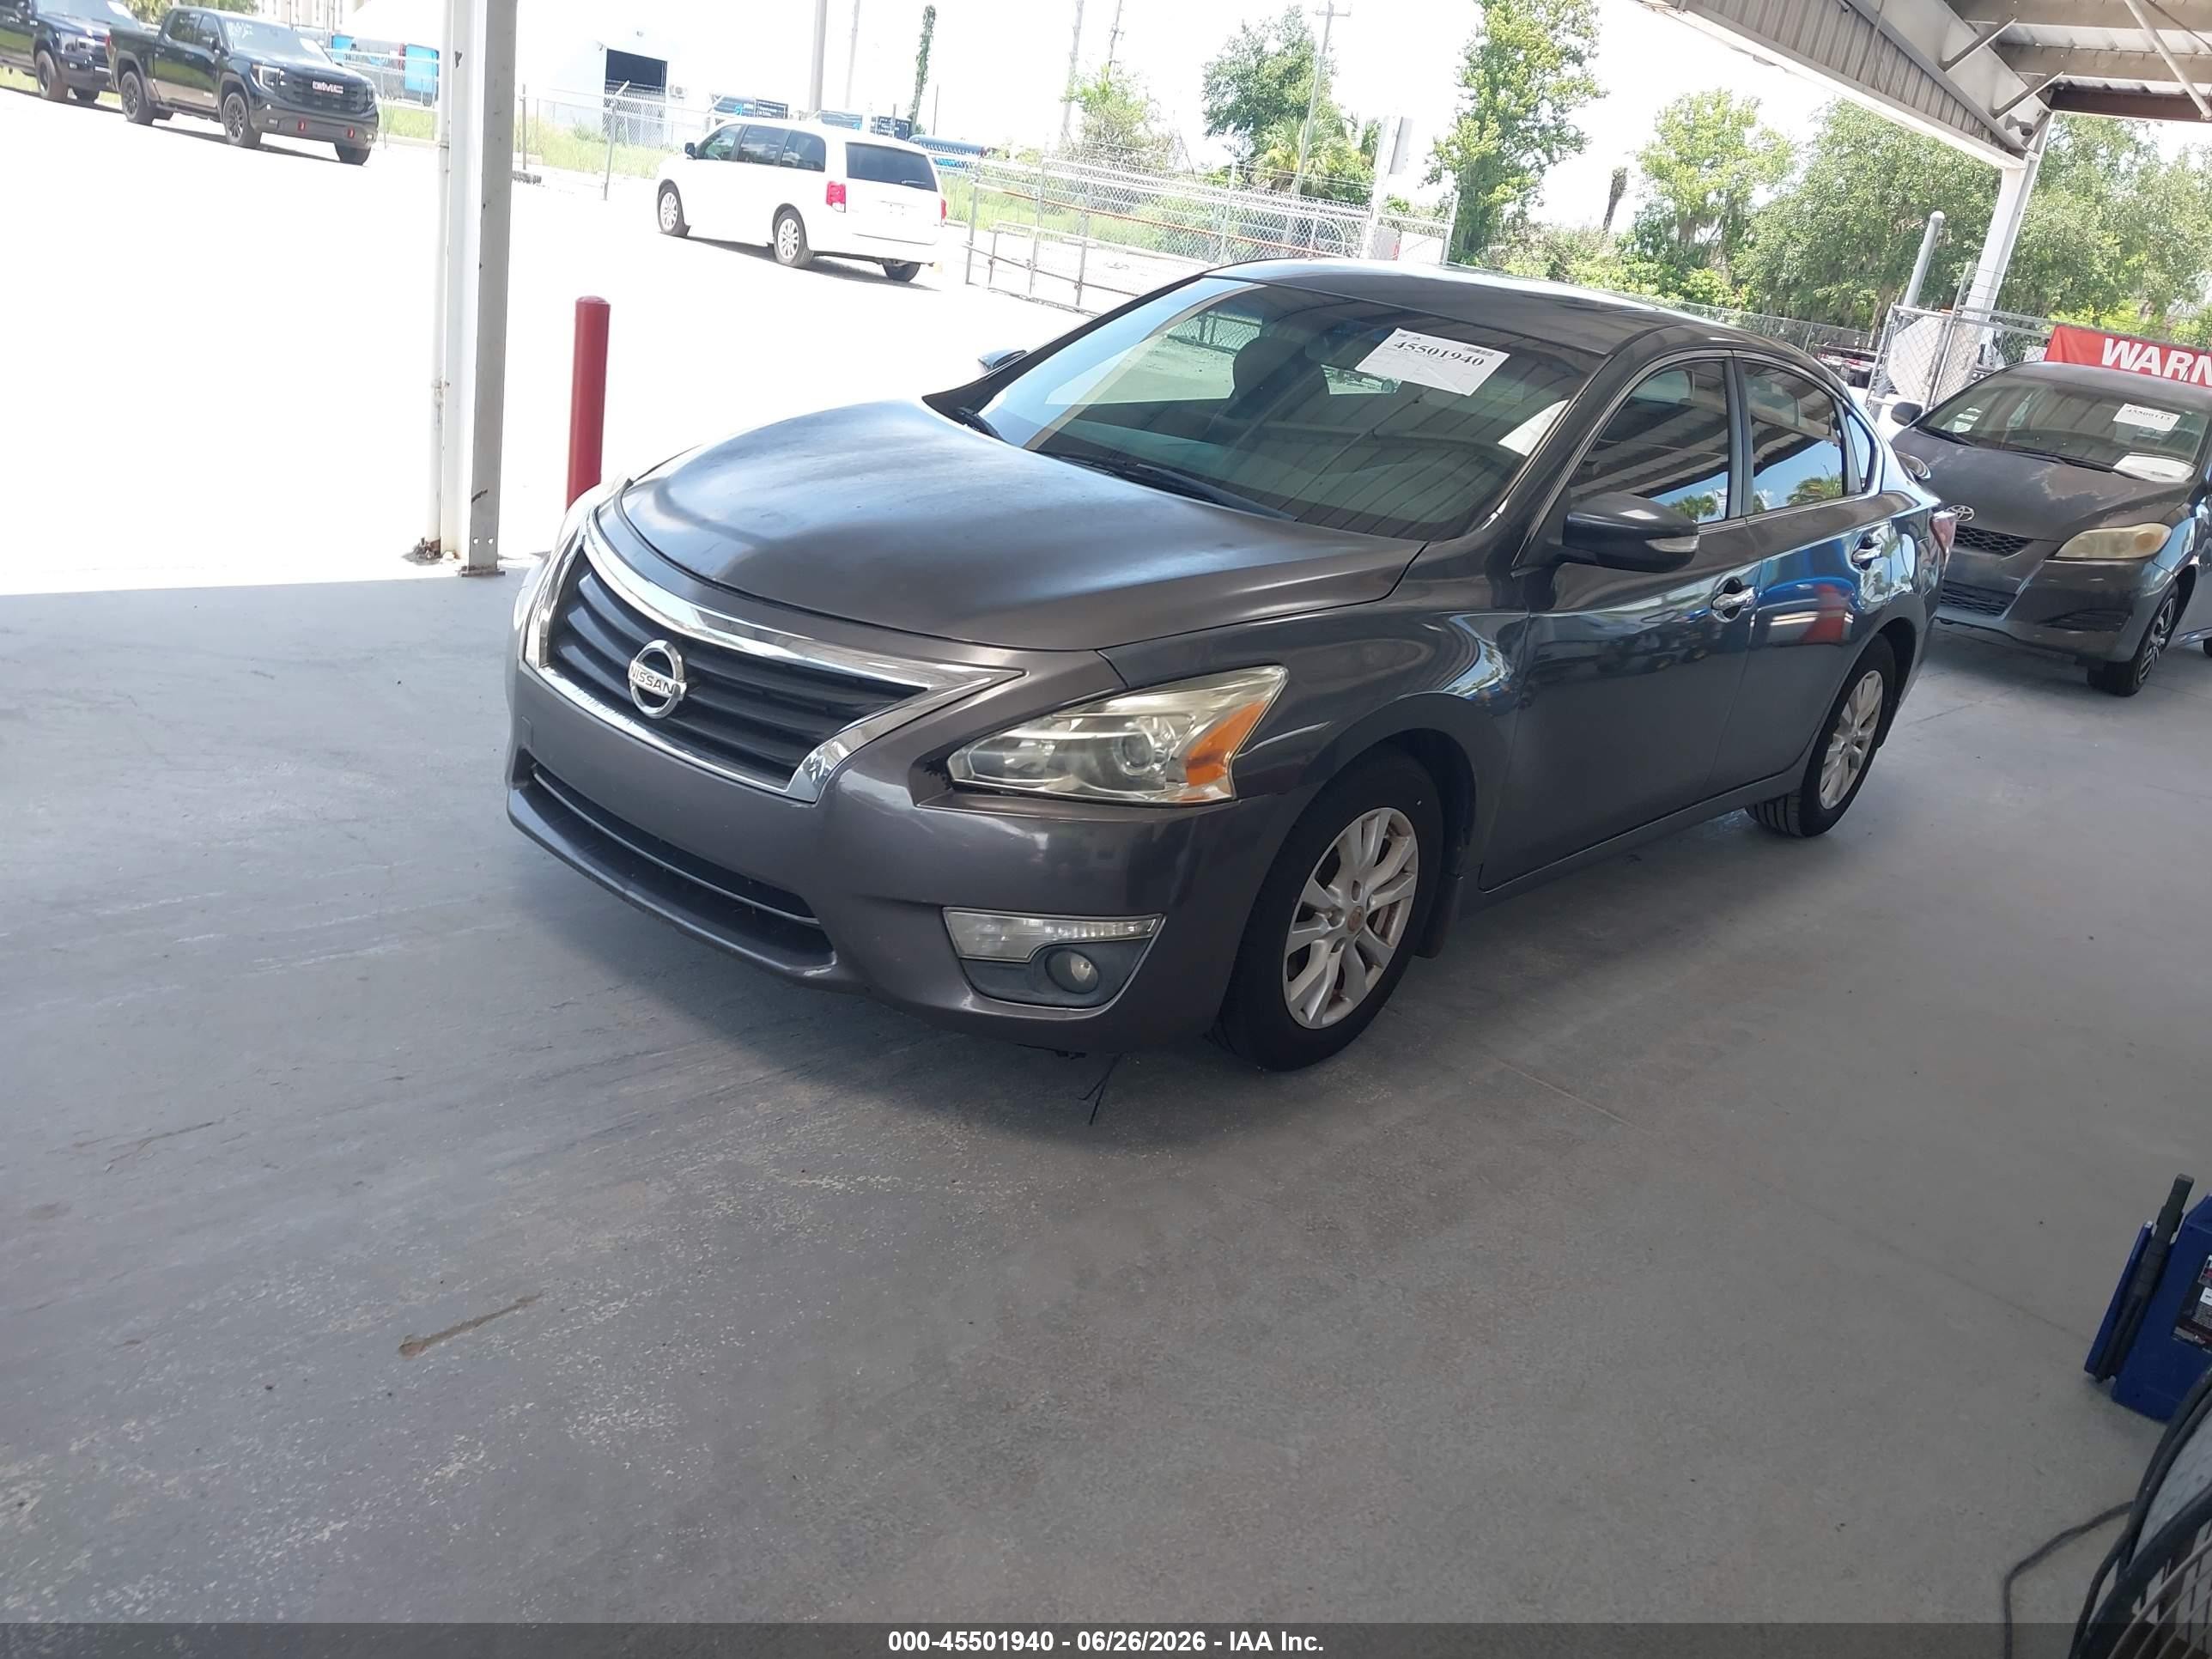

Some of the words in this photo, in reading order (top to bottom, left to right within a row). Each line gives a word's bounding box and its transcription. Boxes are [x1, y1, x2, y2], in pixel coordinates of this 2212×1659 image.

[312, 81, 343, 94] GMC
[1394, 342, 1485, 367] 45501940
[630, 665, 674, 695] NISSAN
